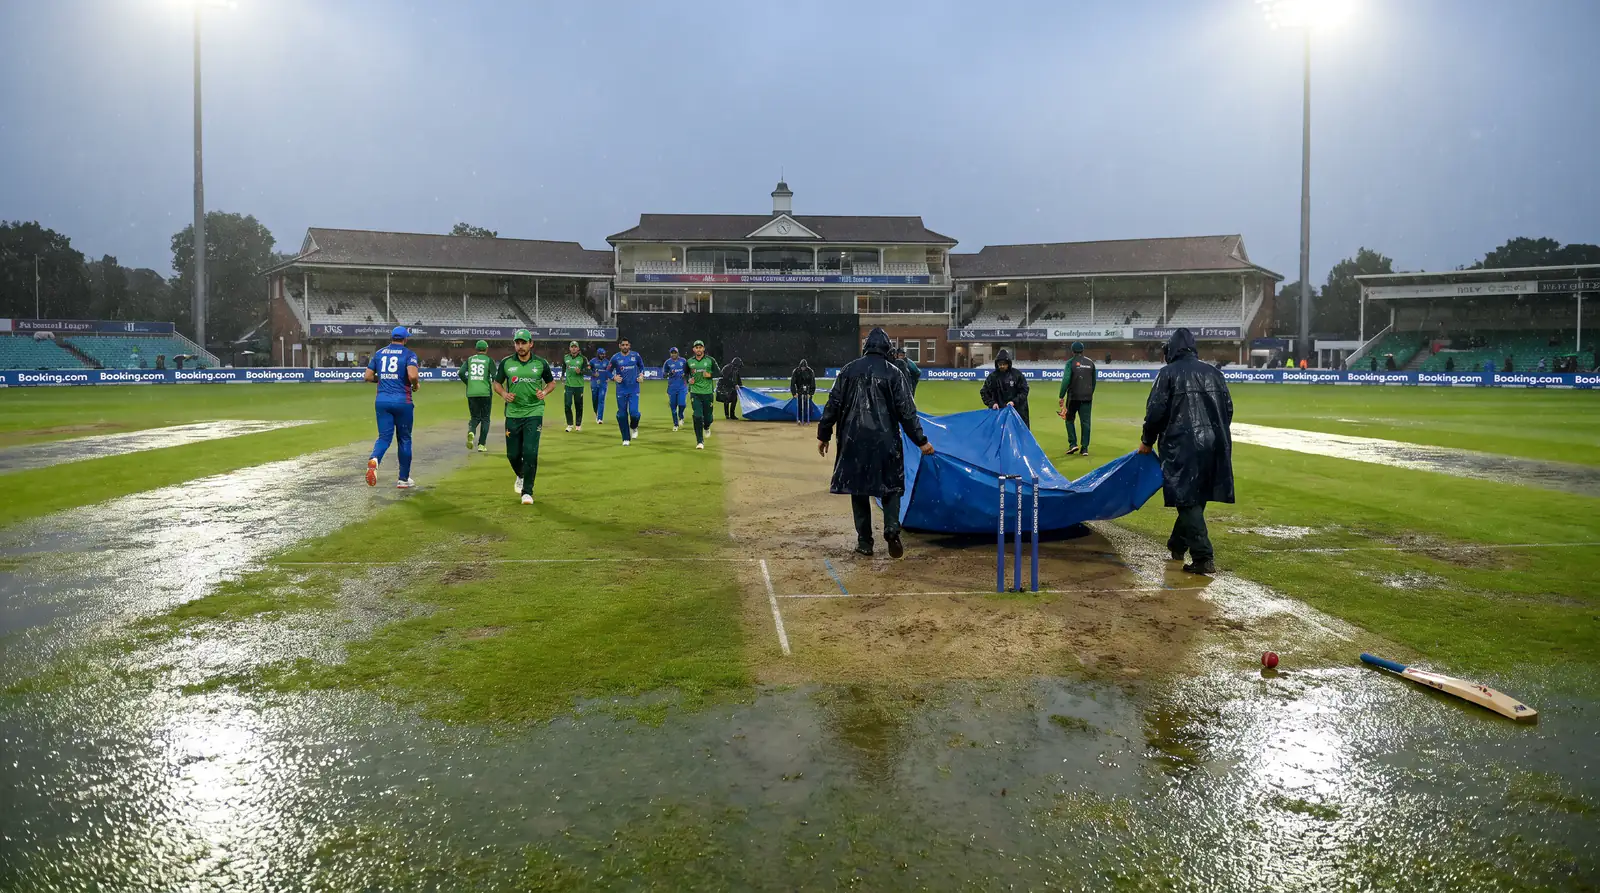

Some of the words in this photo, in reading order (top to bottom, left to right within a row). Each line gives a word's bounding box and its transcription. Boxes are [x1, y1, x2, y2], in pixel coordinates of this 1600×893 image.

[381, 356, 398, 373] 18
[18, 373, 88, 383] Booking.com
[100, 372, 165, 382] Booking.com
[175, 371, 236, 381] Booking.com
[246, 371, 304, 380] Booking.com
[928, 370, 976, 379] Booking.com
[1097, 370, 1150, 380] Booking.com
[1223, 372, 1274, 380] ooking.com
[1282, 372, 1340, 381] Booking.com
[1347, 373, 1408, 383] Booking.com
[1418, 373, 1482, 383] Booking.com
[1494, 374, 1563, 385] Booking.com
